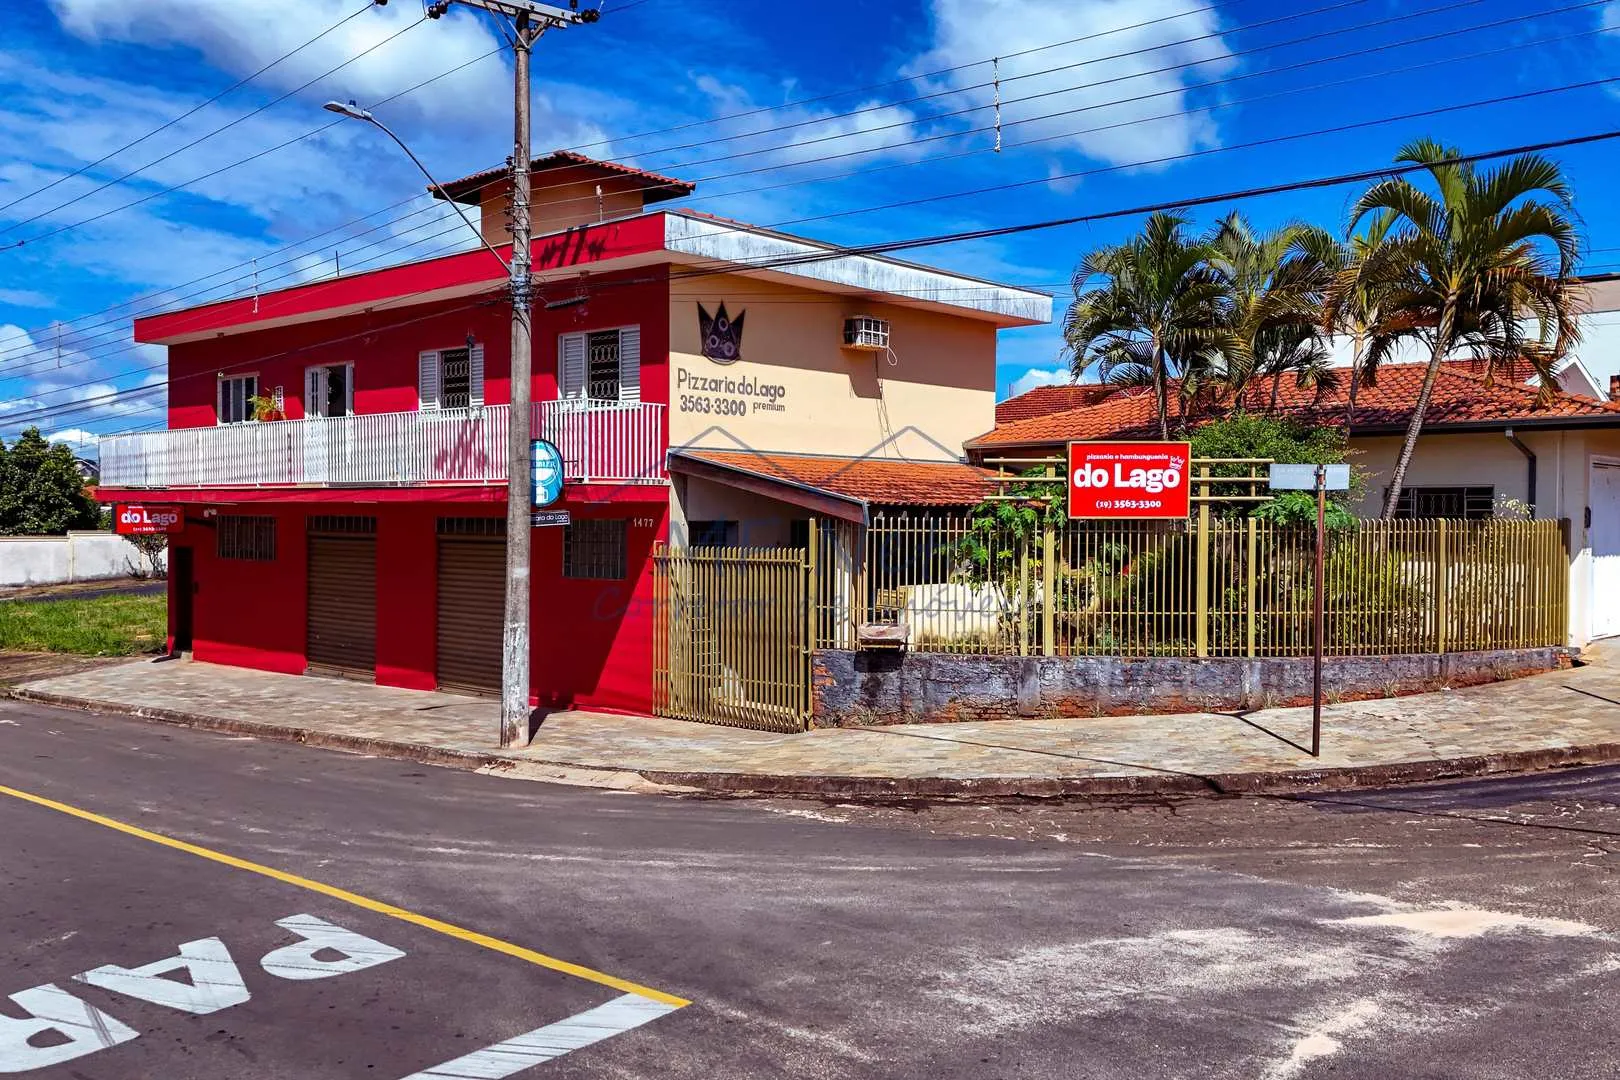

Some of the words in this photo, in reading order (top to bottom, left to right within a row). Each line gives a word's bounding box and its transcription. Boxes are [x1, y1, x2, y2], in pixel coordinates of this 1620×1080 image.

[677, 367, 736, 394] Pizzaria
[752, 401, 786, 413] premium
[1073, 463, 1109, 488] do
[1114, 463, 1180, 493] Lago
[1095, 500, 1112, 509] (19)
[1114, 500, 1162, 509] 3563-3300
[121, 510, 141, 524] do
[143, 510, 178, 526] Lago
[633, 517, 654, 528] 1477
